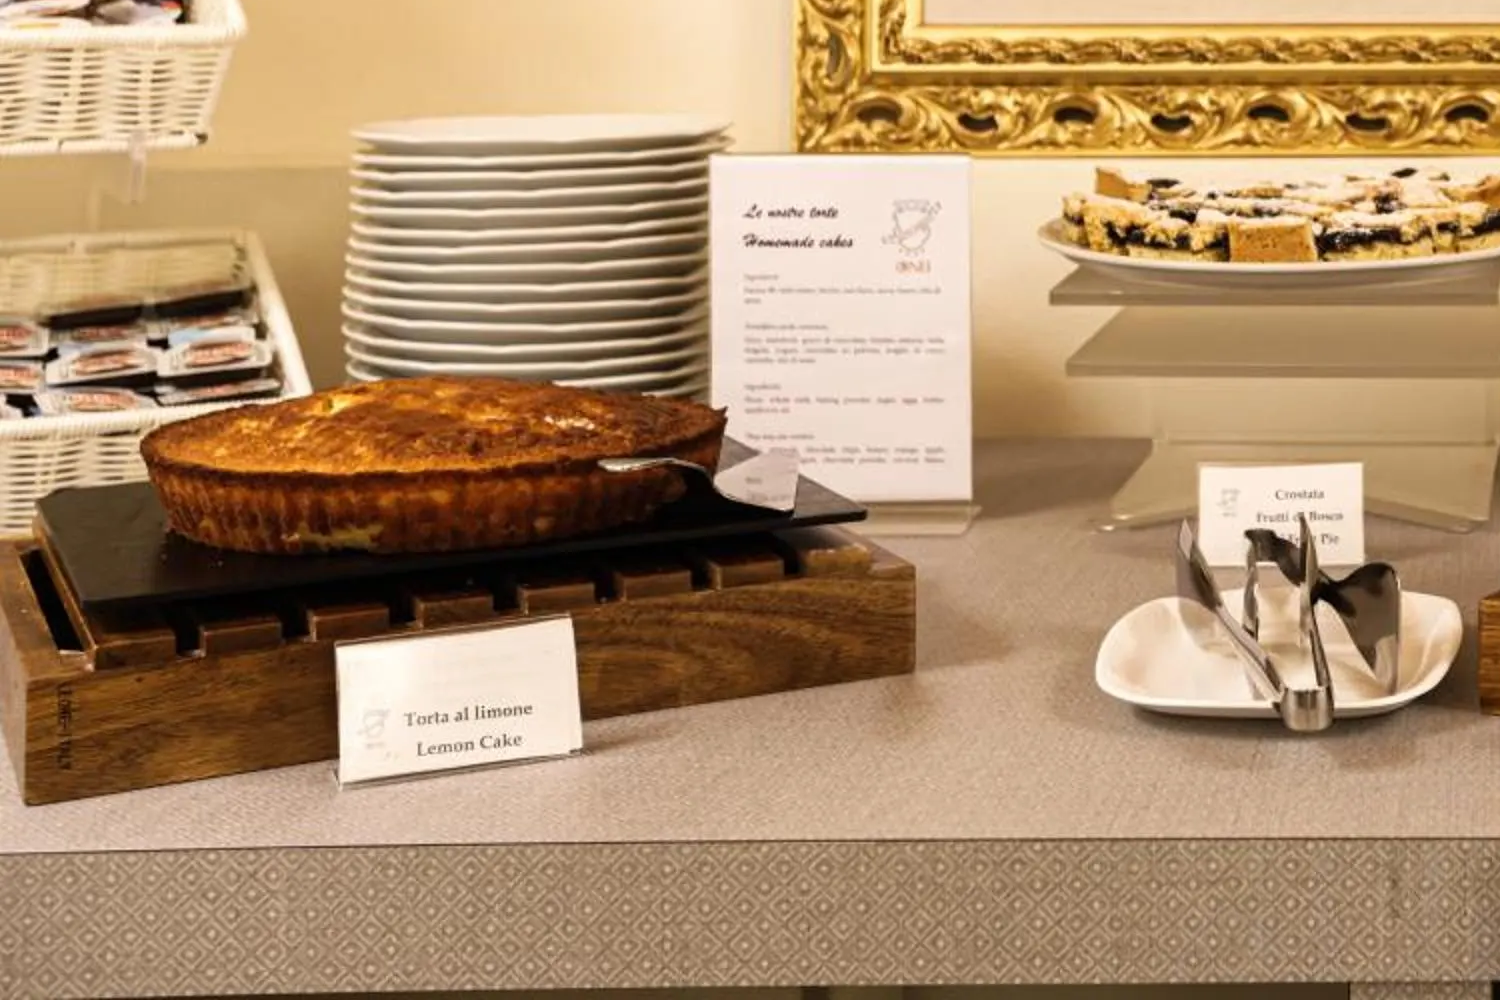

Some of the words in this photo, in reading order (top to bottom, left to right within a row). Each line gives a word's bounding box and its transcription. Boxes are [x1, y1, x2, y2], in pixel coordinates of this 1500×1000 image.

[742, 204, 762, 219] Le
[768, 207, 804, 219] nostre
[809, 206, 838, 219] torte
[742, 233, 814, 248] Homemade
[819, 233, 853, 248] cakes
[1275, 488, 1325, 501] Crostata
[1256, 511, 1289, 523] Frutti
[1309, 511, 1344, 521] Bosco
[404, 710, 449, 727] Torta
[453, 707, 469, 722] al
[474, 704, 533, 721] limone
[416, 739, 475, 757] Lemon
[479, 733, 523, 749] Cake
